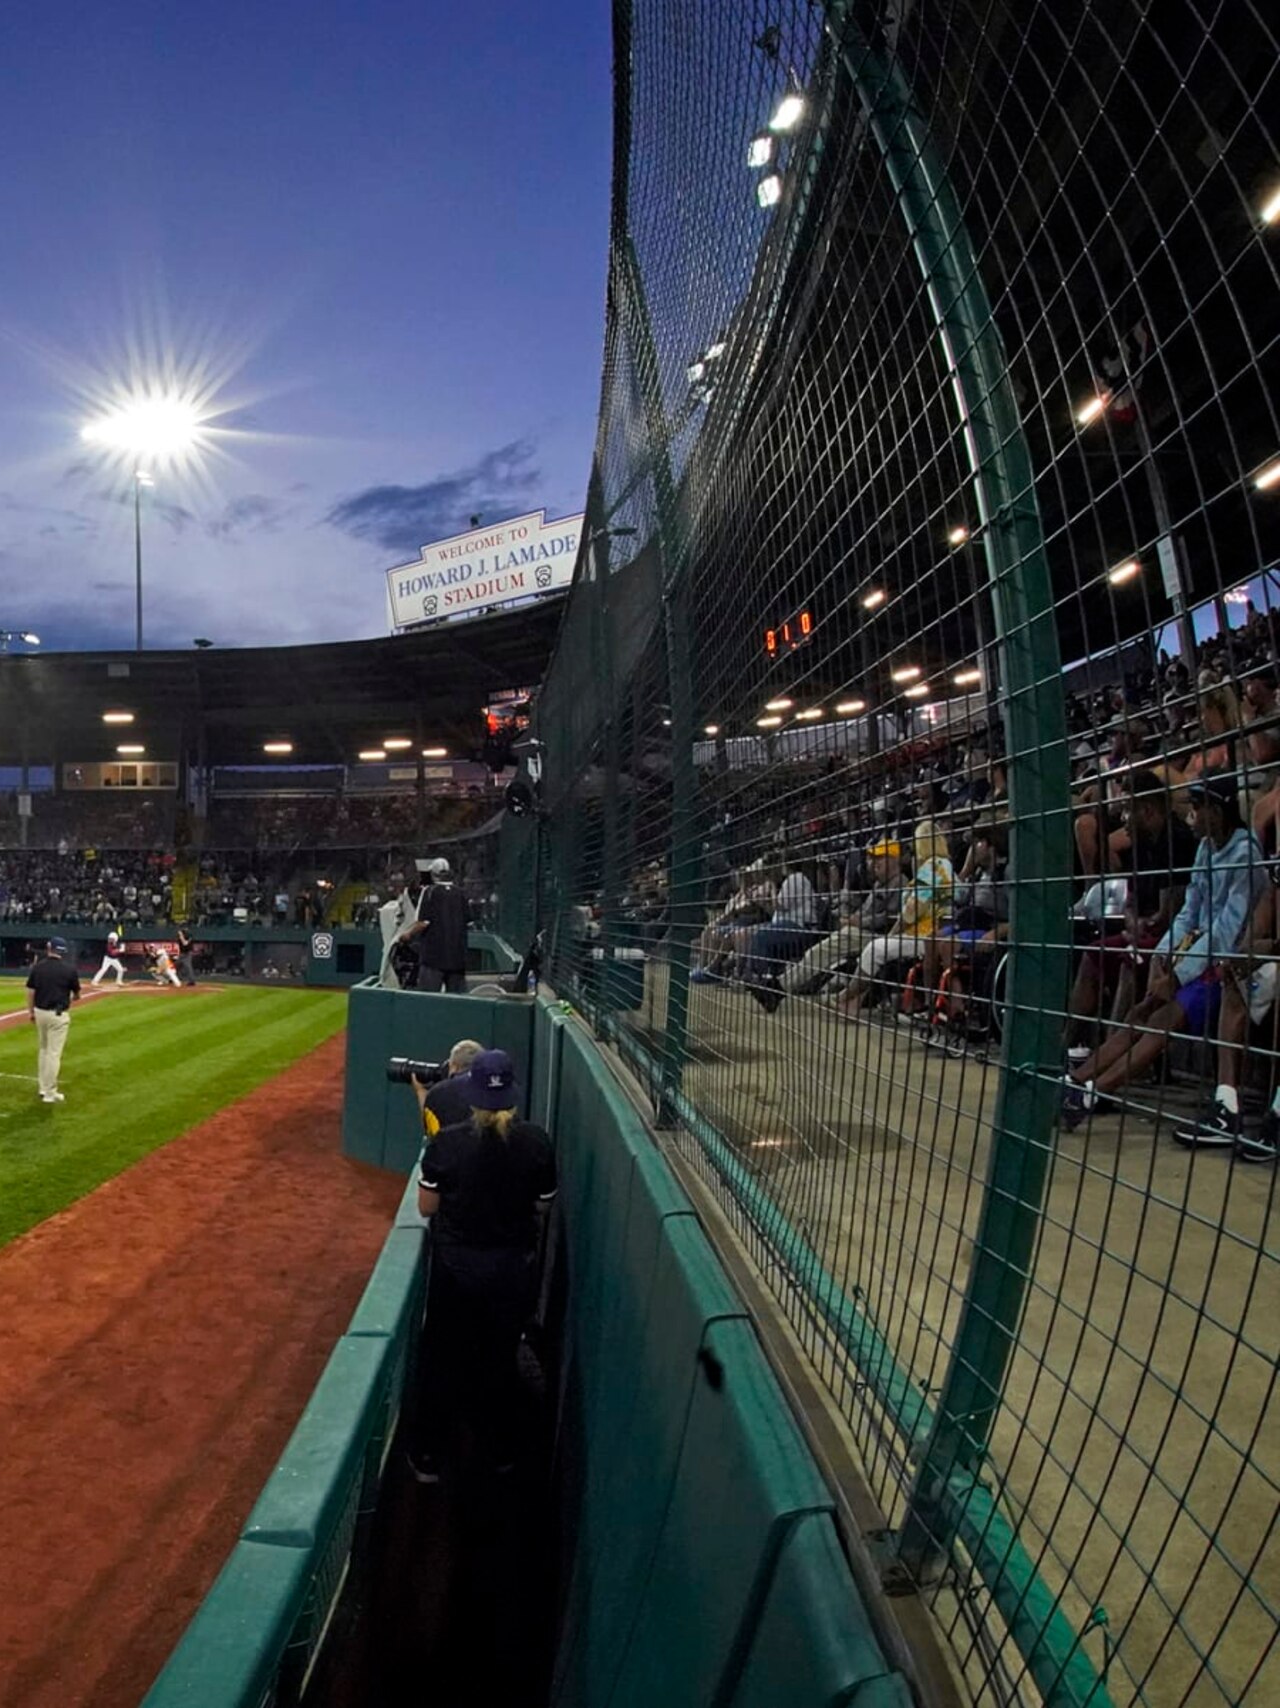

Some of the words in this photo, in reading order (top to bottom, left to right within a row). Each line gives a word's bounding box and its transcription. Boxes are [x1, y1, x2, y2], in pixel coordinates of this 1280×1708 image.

[438, 533, 505, 561] WELCOME
[508, 526, 528, 540] TO
[398, 563, 472, 598] HOWARD
[477, 559, 489, 577] J.
[495, 534, 577, 572] LAMADE
[443, 571, 525, 606] STADIUM
